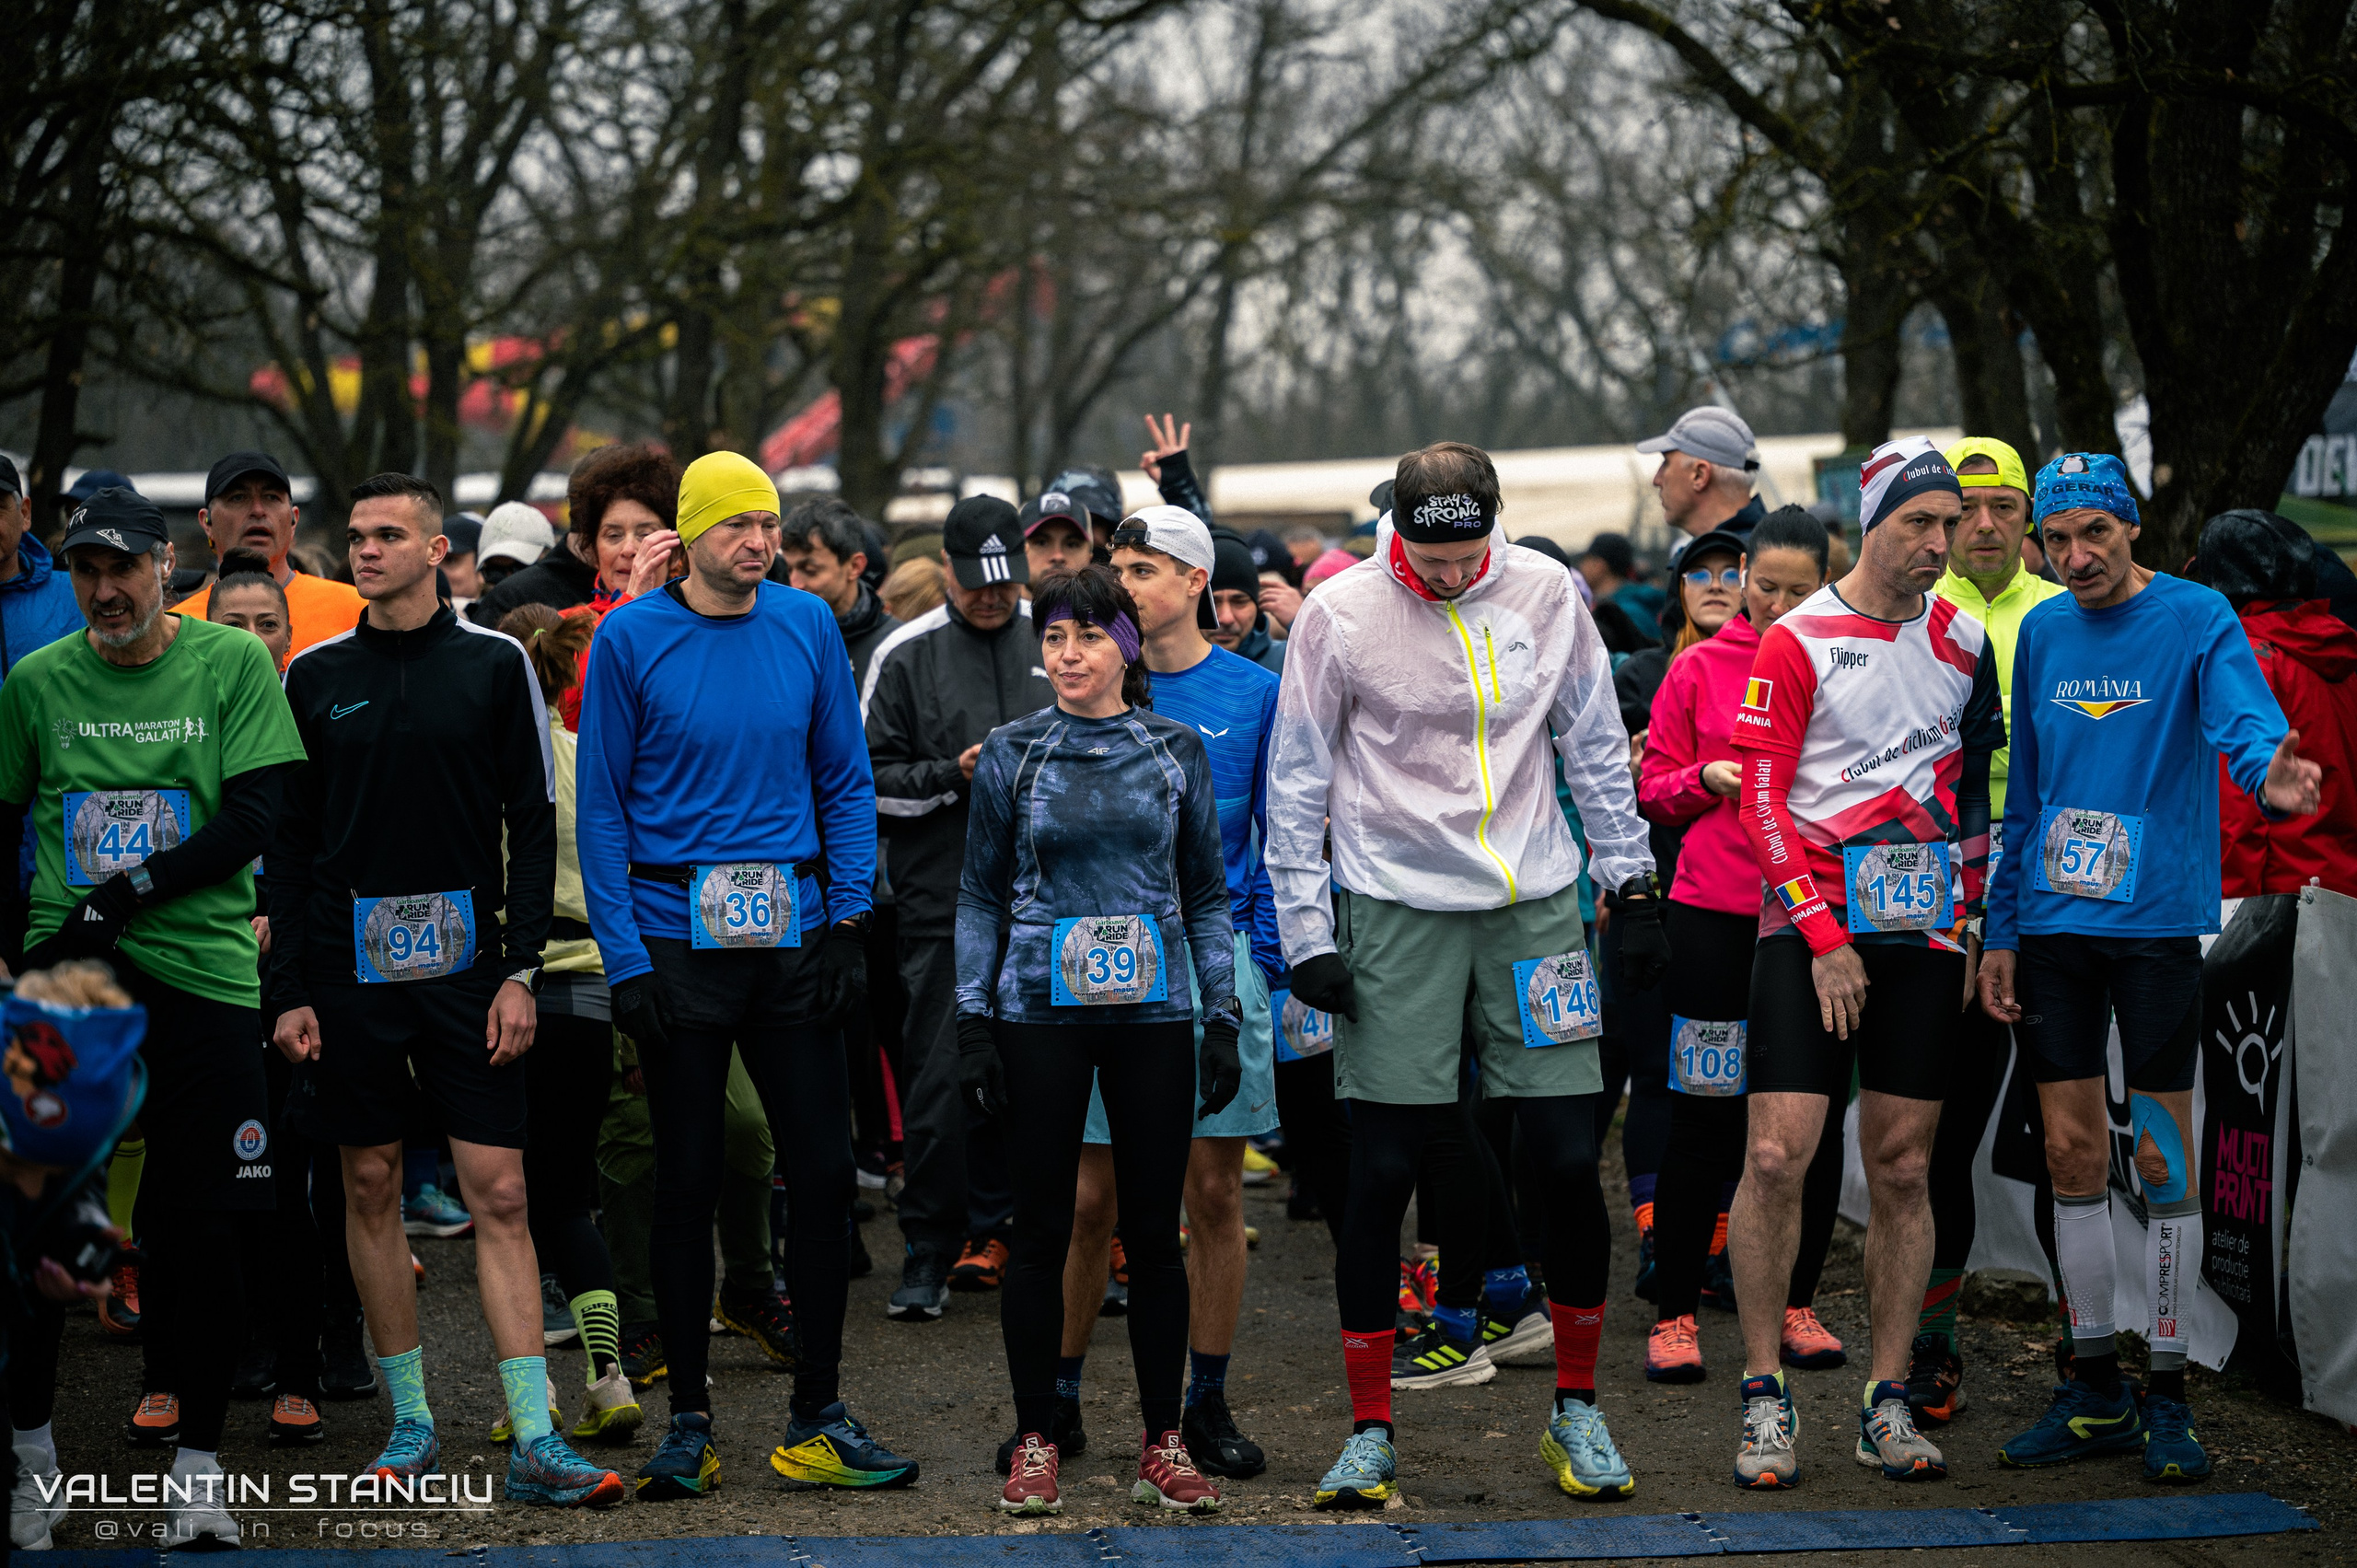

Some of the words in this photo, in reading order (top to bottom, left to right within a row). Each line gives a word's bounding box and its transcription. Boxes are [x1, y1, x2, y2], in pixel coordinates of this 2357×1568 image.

[1903, 465, 1930, 482] Clubul
[1932, 464, 1942, 473] de
[2051, 482, 2115, 497] GERAR
[1428, 494, 1460, 507] STAY
[1413, 502, 1481, 528] STRONG
[1454, 520, 1481, 528] PRO
[979, 545, 1006, 554] adidas
[1829, 647, 1869, 669] Flipper
[2056, 675, 2141, 698] ROMÂNIA
[78, 722, 134, 738] ULTRA
[134, 719, 180, 730] MARATON
[1087, 747, 1110, 755] 4F
[1841, 756, 1881, 783] Clubul
[1885, 747, 1898, 762] de
[1902, 723, 1944, 755] Ciclism
[1754, 759, 1772, 789] Galati
[118, 800, 144, 808] RUN
[118, 808, 144, 817] RIDE
[1761, 817, 1778, 831] de
[2081, 826, 2102, 835] RIDE
[2083, 819, 2103, 828] RUN
[97, 822, 155, 863] 44
[1764, 830, 1789, 865] Clubul
[1898, 852, 1919, 860] RUN
[2061, 837, 2107, 877] 57
[1868, 873, 1936, 912] 145
[726, 891, 771, 928] 36
[388, 922, 441, 962] 94
[1086, 946, 1137, 984] 39
[1567, 960, 1583, 969] RUN
[1568, 969, 1584, 977] RIDE
[1541, 979, 1599, 1024] 146
[1681, 1044, 1741, 1080] 108
[2217, 1120, 2270, 1179] MULTI
[236, 1165, 272, 1179] JAKO
[2213, 1170, 2273, 1225] PRINT
[2212, 1228, 2237, 1250] atelier
[2238, 1233, 2250, 1255] de
